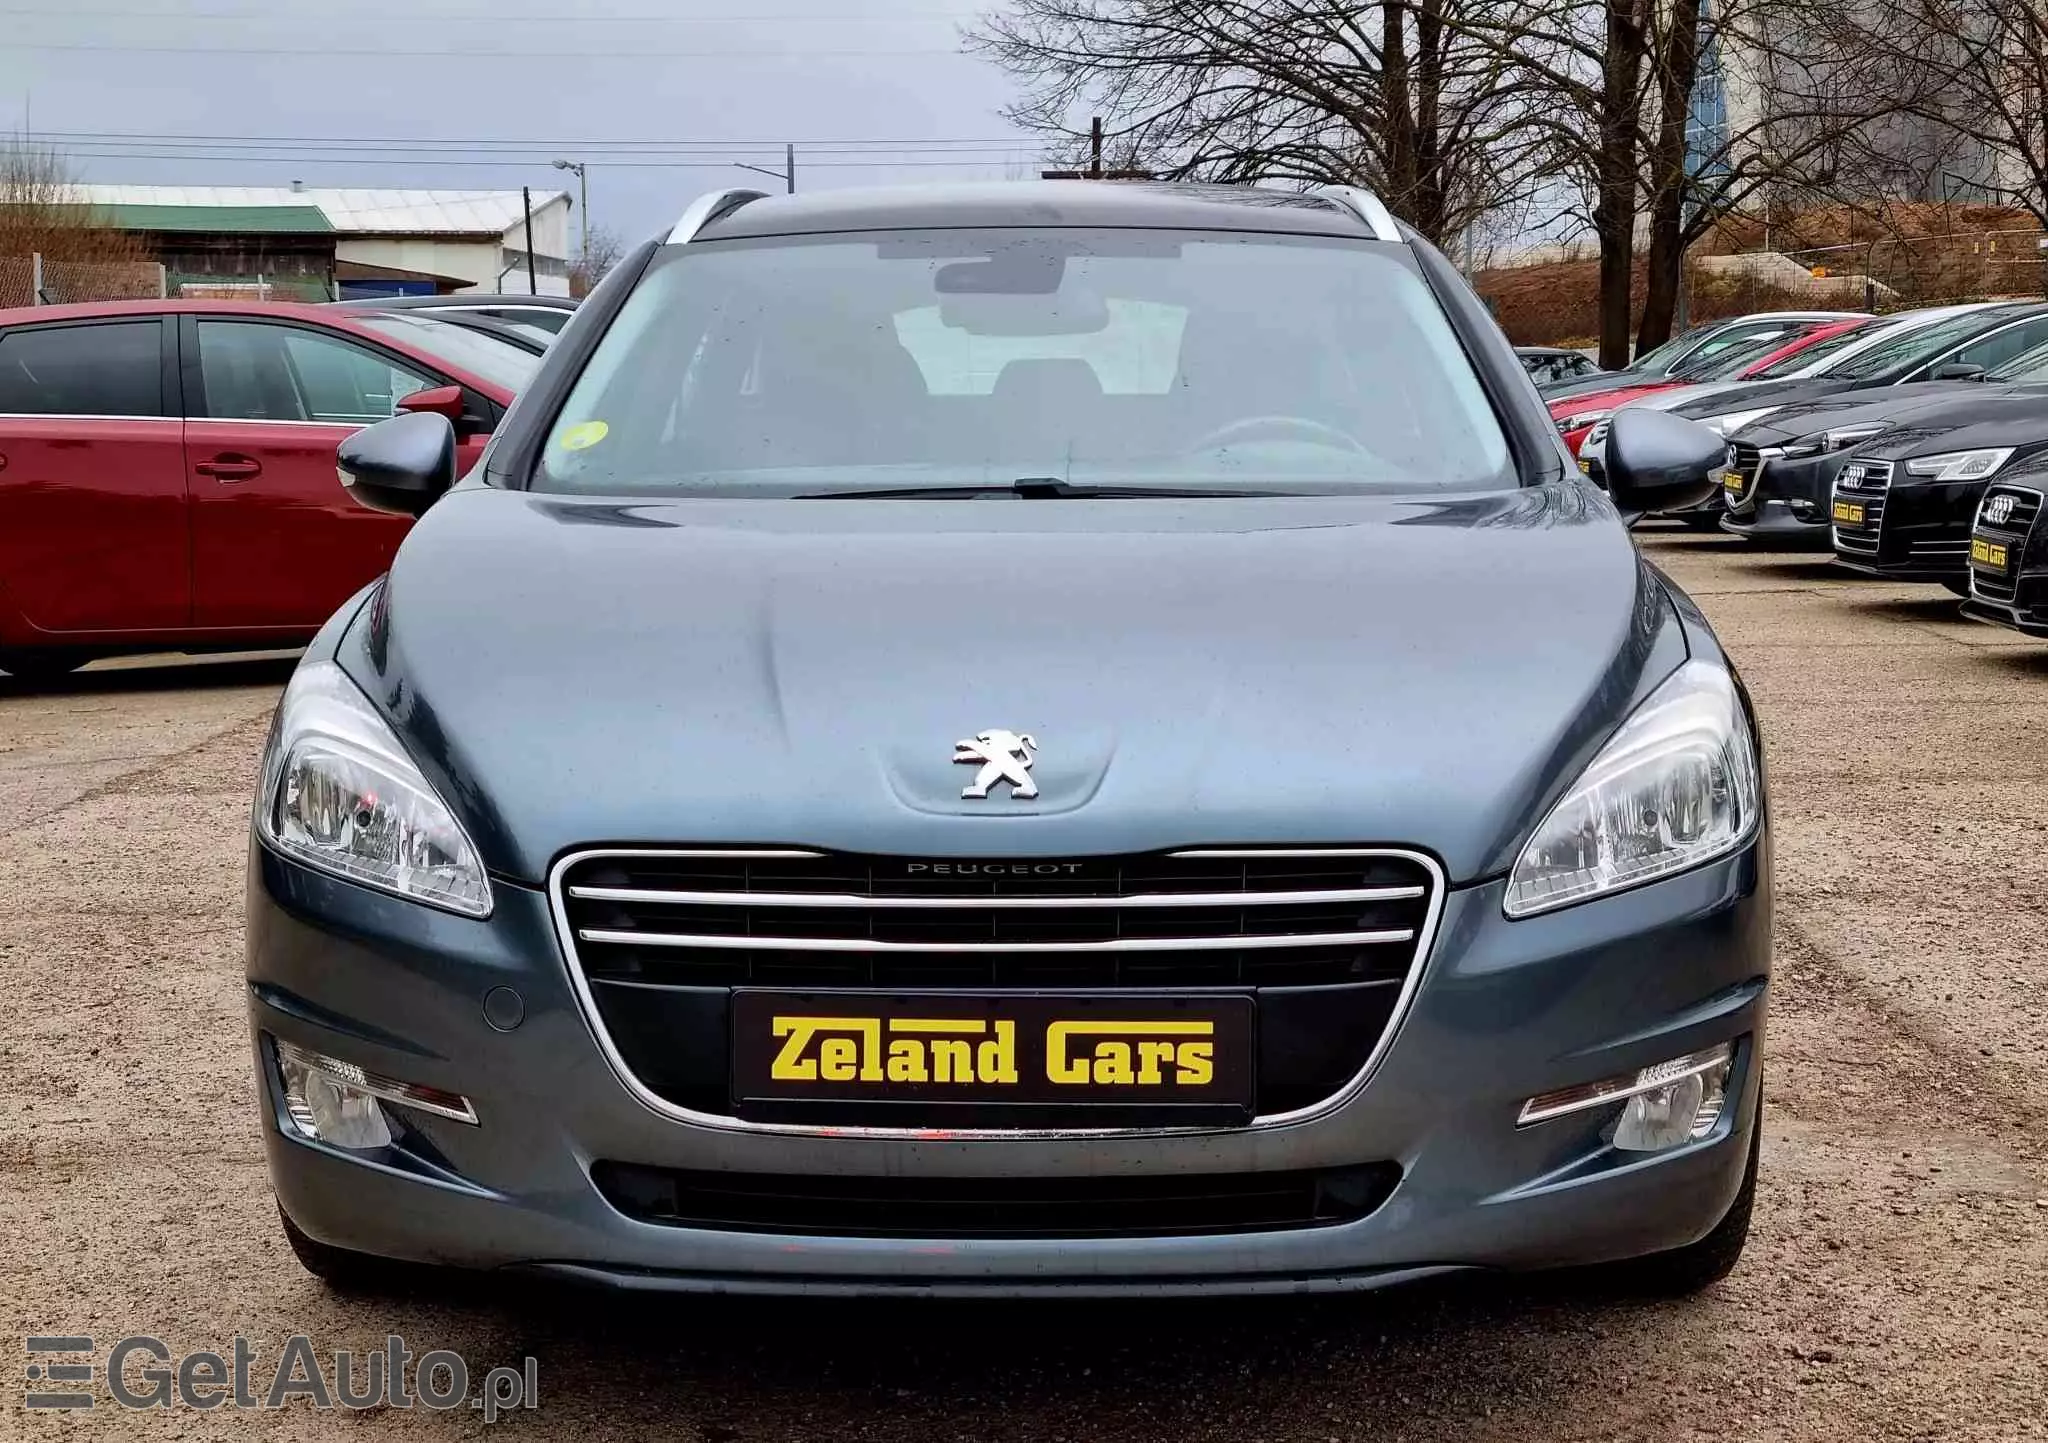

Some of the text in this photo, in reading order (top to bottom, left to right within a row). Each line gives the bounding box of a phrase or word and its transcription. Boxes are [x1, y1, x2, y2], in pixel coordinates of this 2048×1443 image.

[907, 863, 1083, 874] PEUGEOT
[771, 1016, 1214, 1085] Zeland Cars
